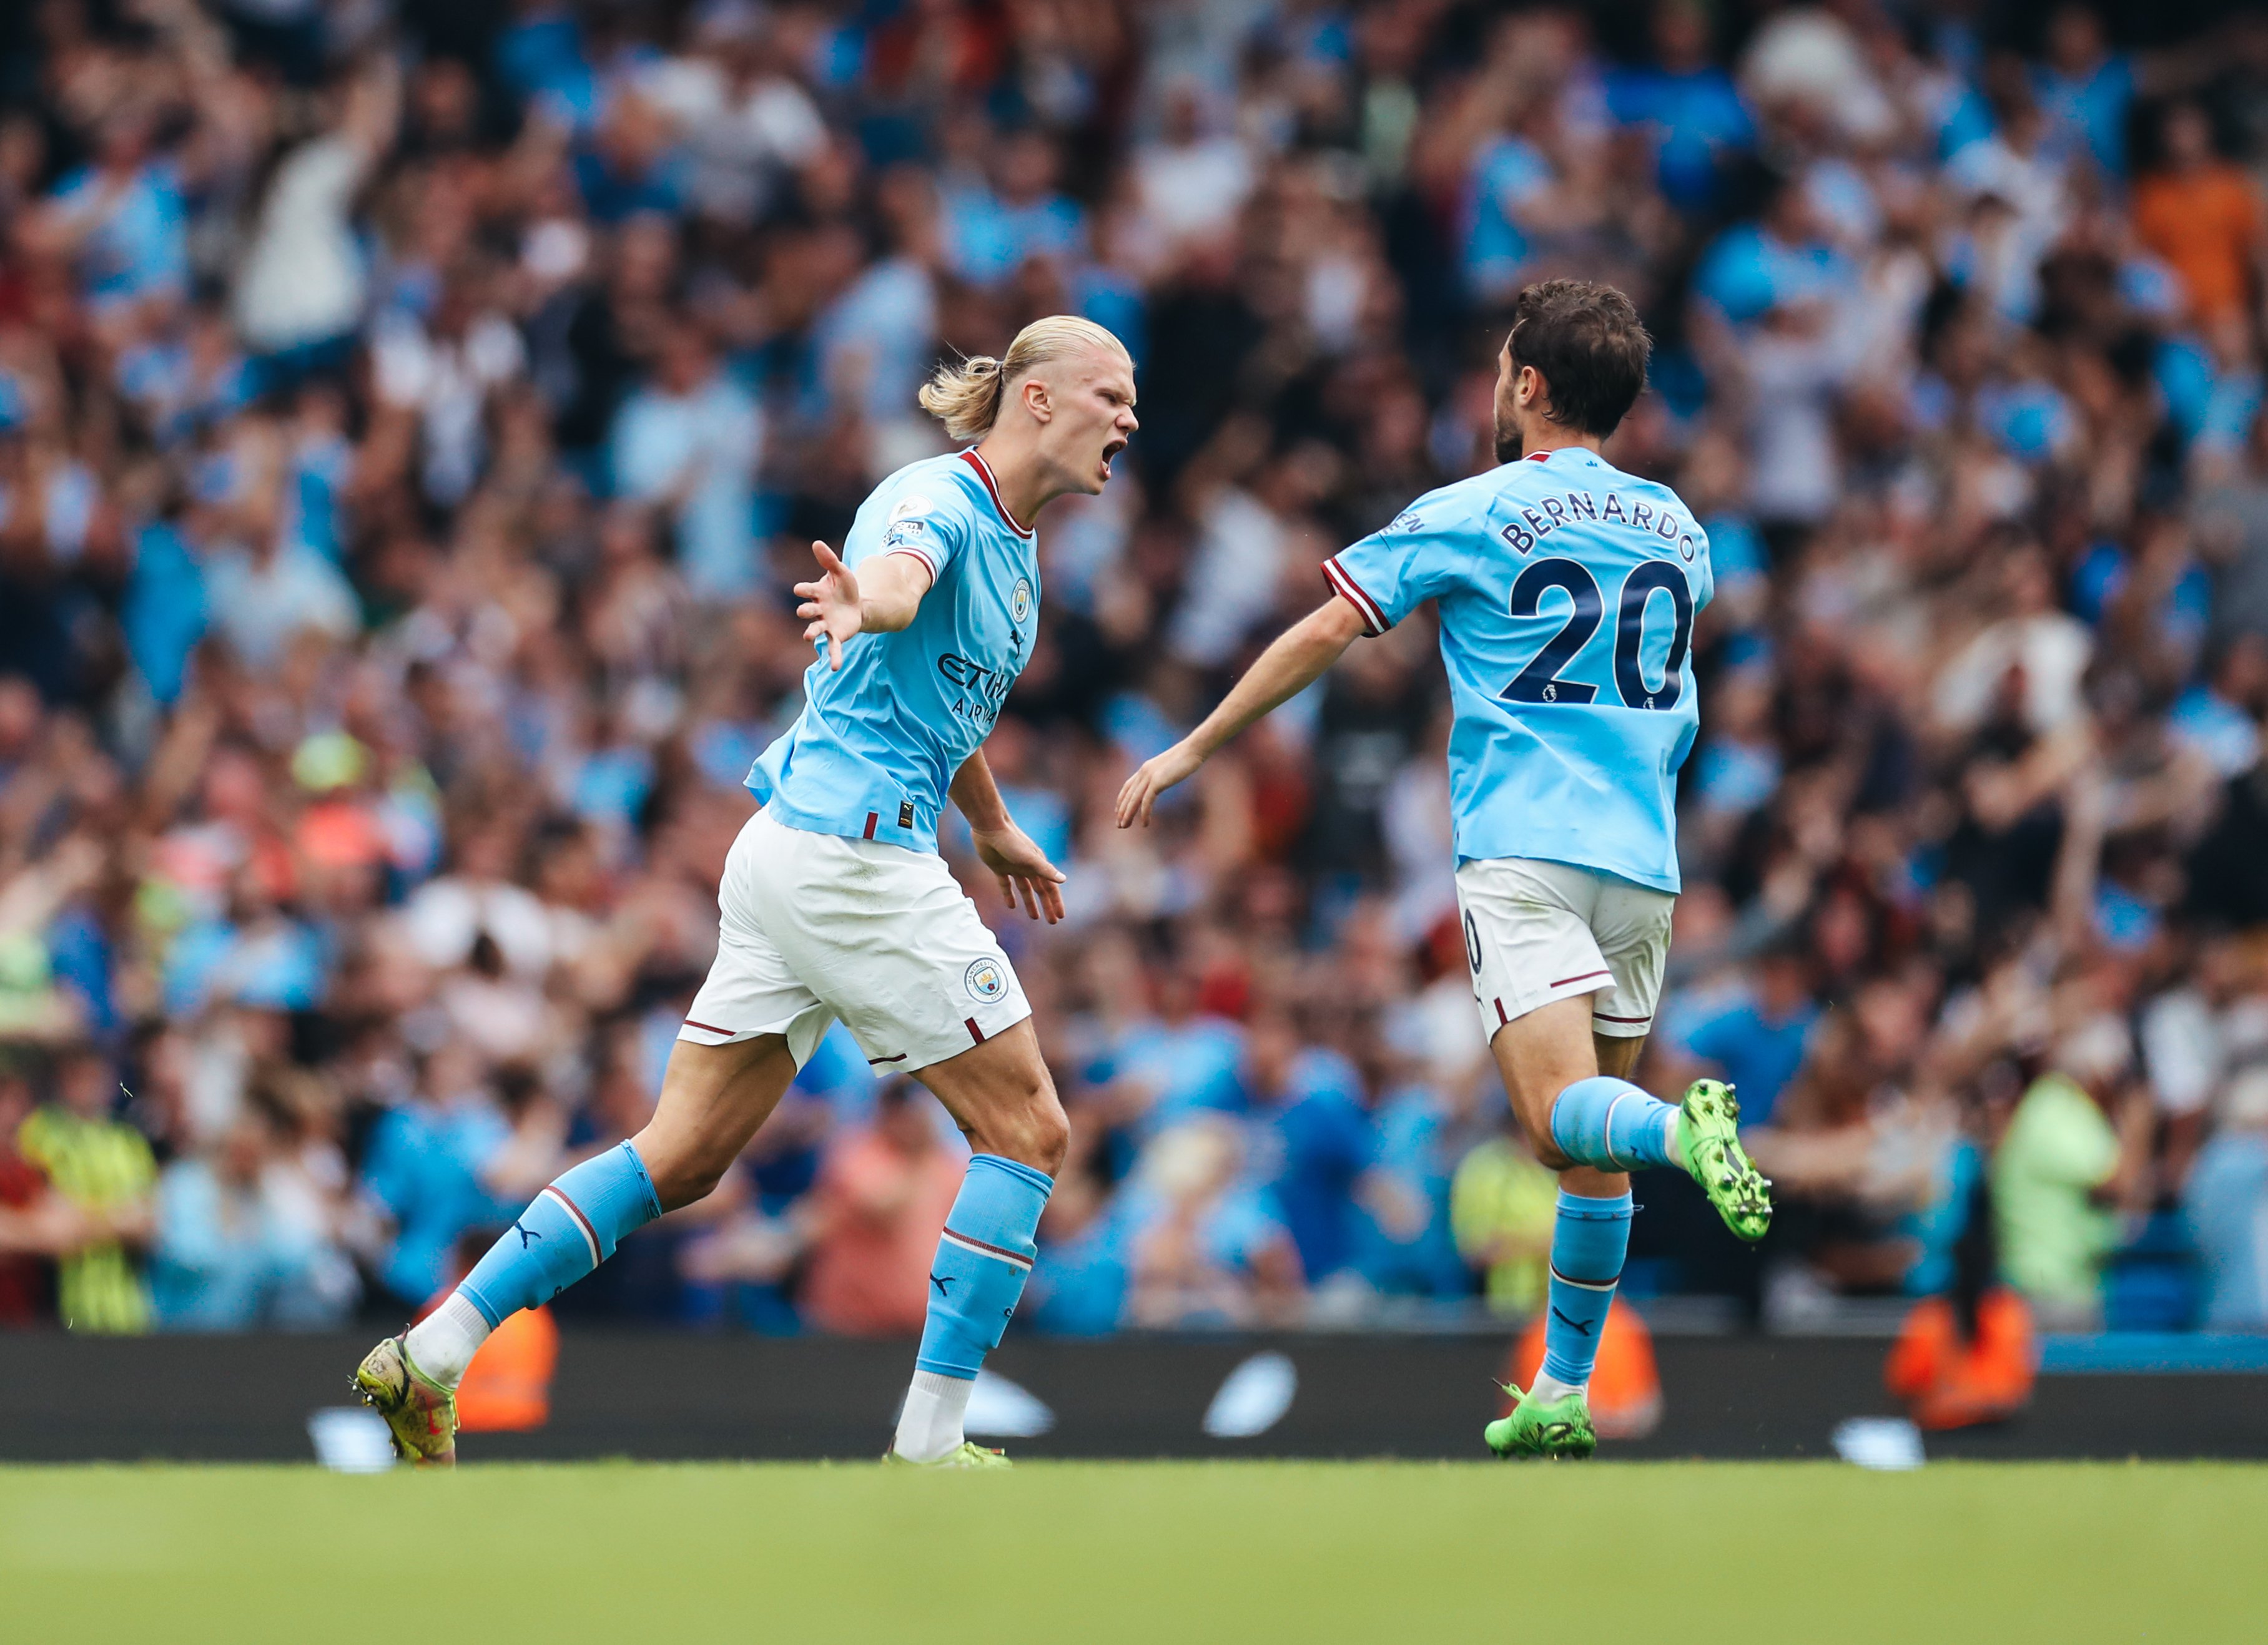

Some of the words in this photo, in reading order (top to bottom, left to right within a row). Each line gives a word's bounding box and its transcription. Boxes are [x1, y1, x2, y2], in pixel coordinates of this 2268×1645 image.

[1499, 491, 1695, 564] BERNARDO
[1497, 556, 1695, 710] 20
[969, 962, 997, 984] MANCHESTER
[991, 991, 1002, 1000] CITY
